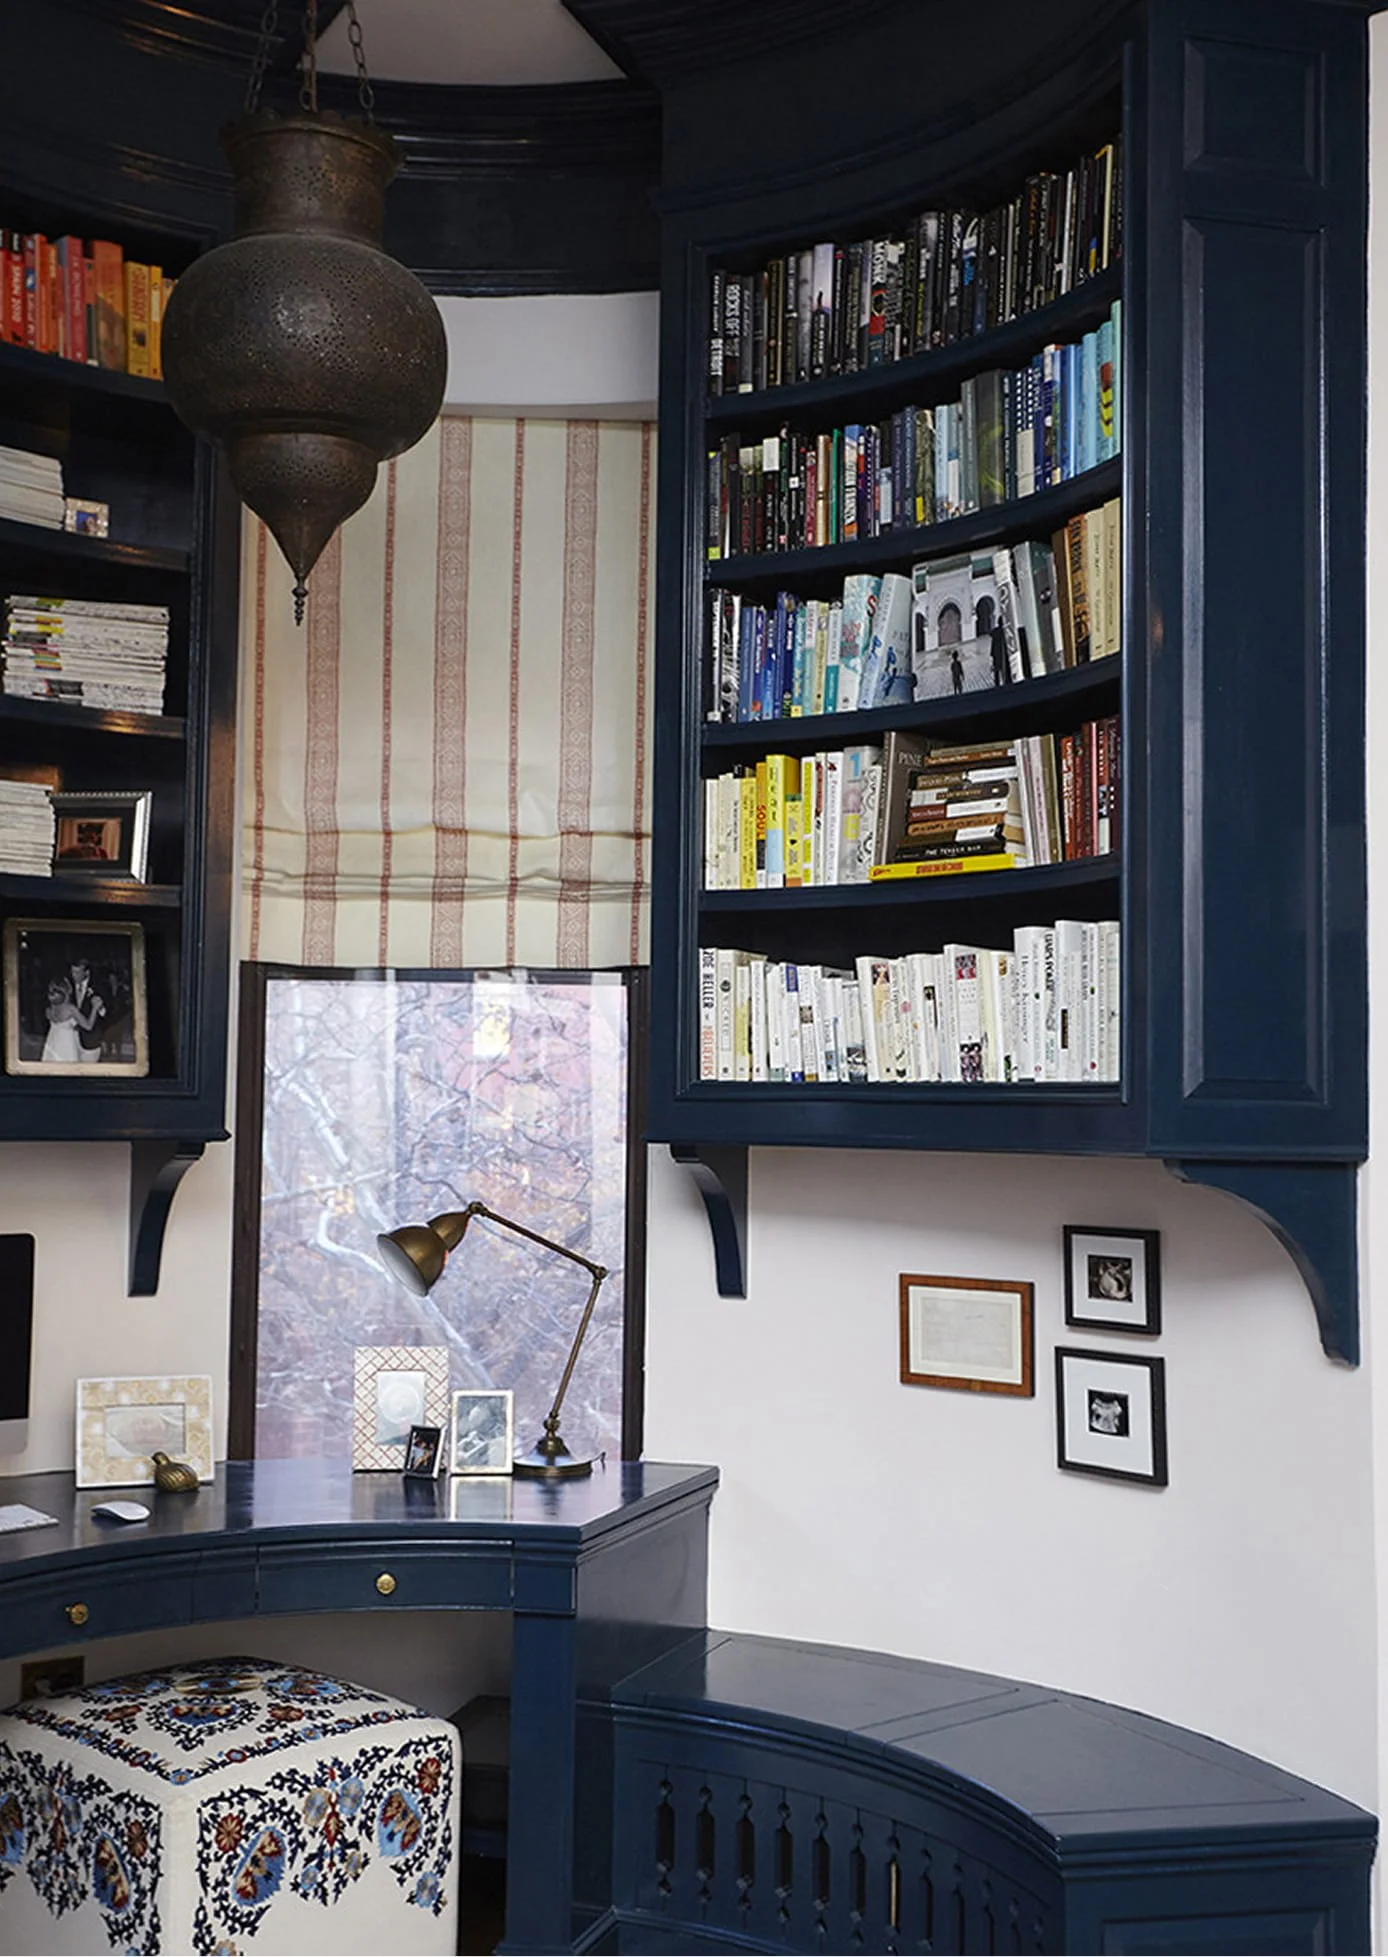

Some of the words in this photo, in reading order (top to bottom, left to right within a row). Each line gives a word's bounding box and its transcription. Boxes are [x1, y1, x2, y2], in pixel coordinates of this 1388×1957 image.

[872, 240, 887, 285] MONK
[725, 318, 741, 336] OFF
[710, 338, 723, 376] DETROIT
[756, 804, 767, 838] SOUL
[702, 973, 715, 1009] HELLER
